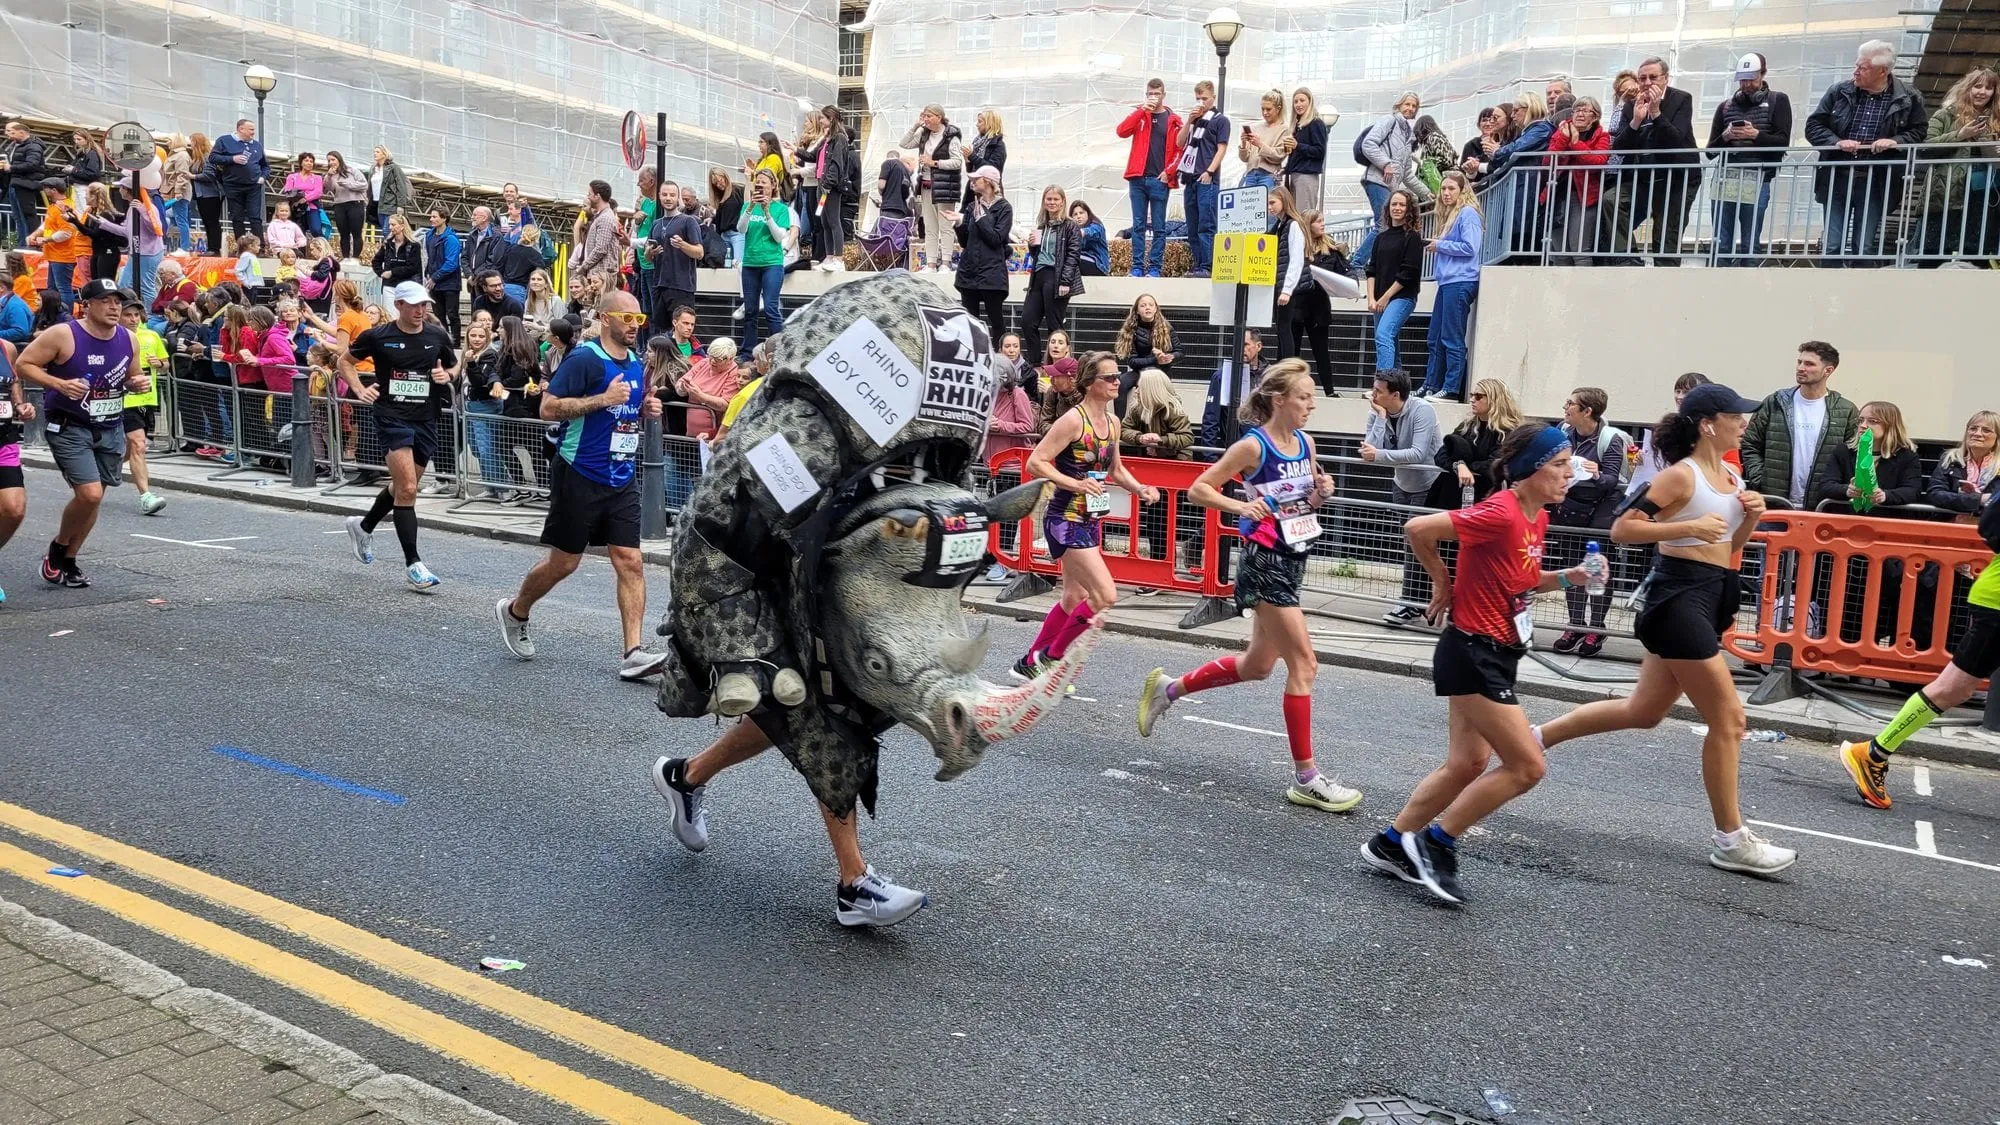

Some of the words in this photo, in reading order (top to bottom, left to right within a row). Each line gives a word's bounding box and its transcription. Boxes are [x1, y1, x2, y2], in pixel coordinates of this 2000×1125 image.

[1241, 189, 1259, 197] Permit
[1222, 194, 1233, 209] P
[1217, 255, 1237, 264] NOTICE
[1248, 255, 1272, 265] NOTICE
[1219, 267, 1232, 275] Parking
[1252, 268, 1268, 276] Parking
[862, 339, 910, 389] RHINO
[929, 366, 975, 385] SAVE
[394, 382, 425, 393] 30246
[826, 351, 861, 382] BOY
[856, 381, 899, 426] CHRIS
[95, 401, 121, 413] 27229
[768, 444, 794, 476] RHINO
[790, 475, 810, 494] BOY
[1277, 458, 1312, 480] SARAH
[765, 463, 792, 492] CHRIS
